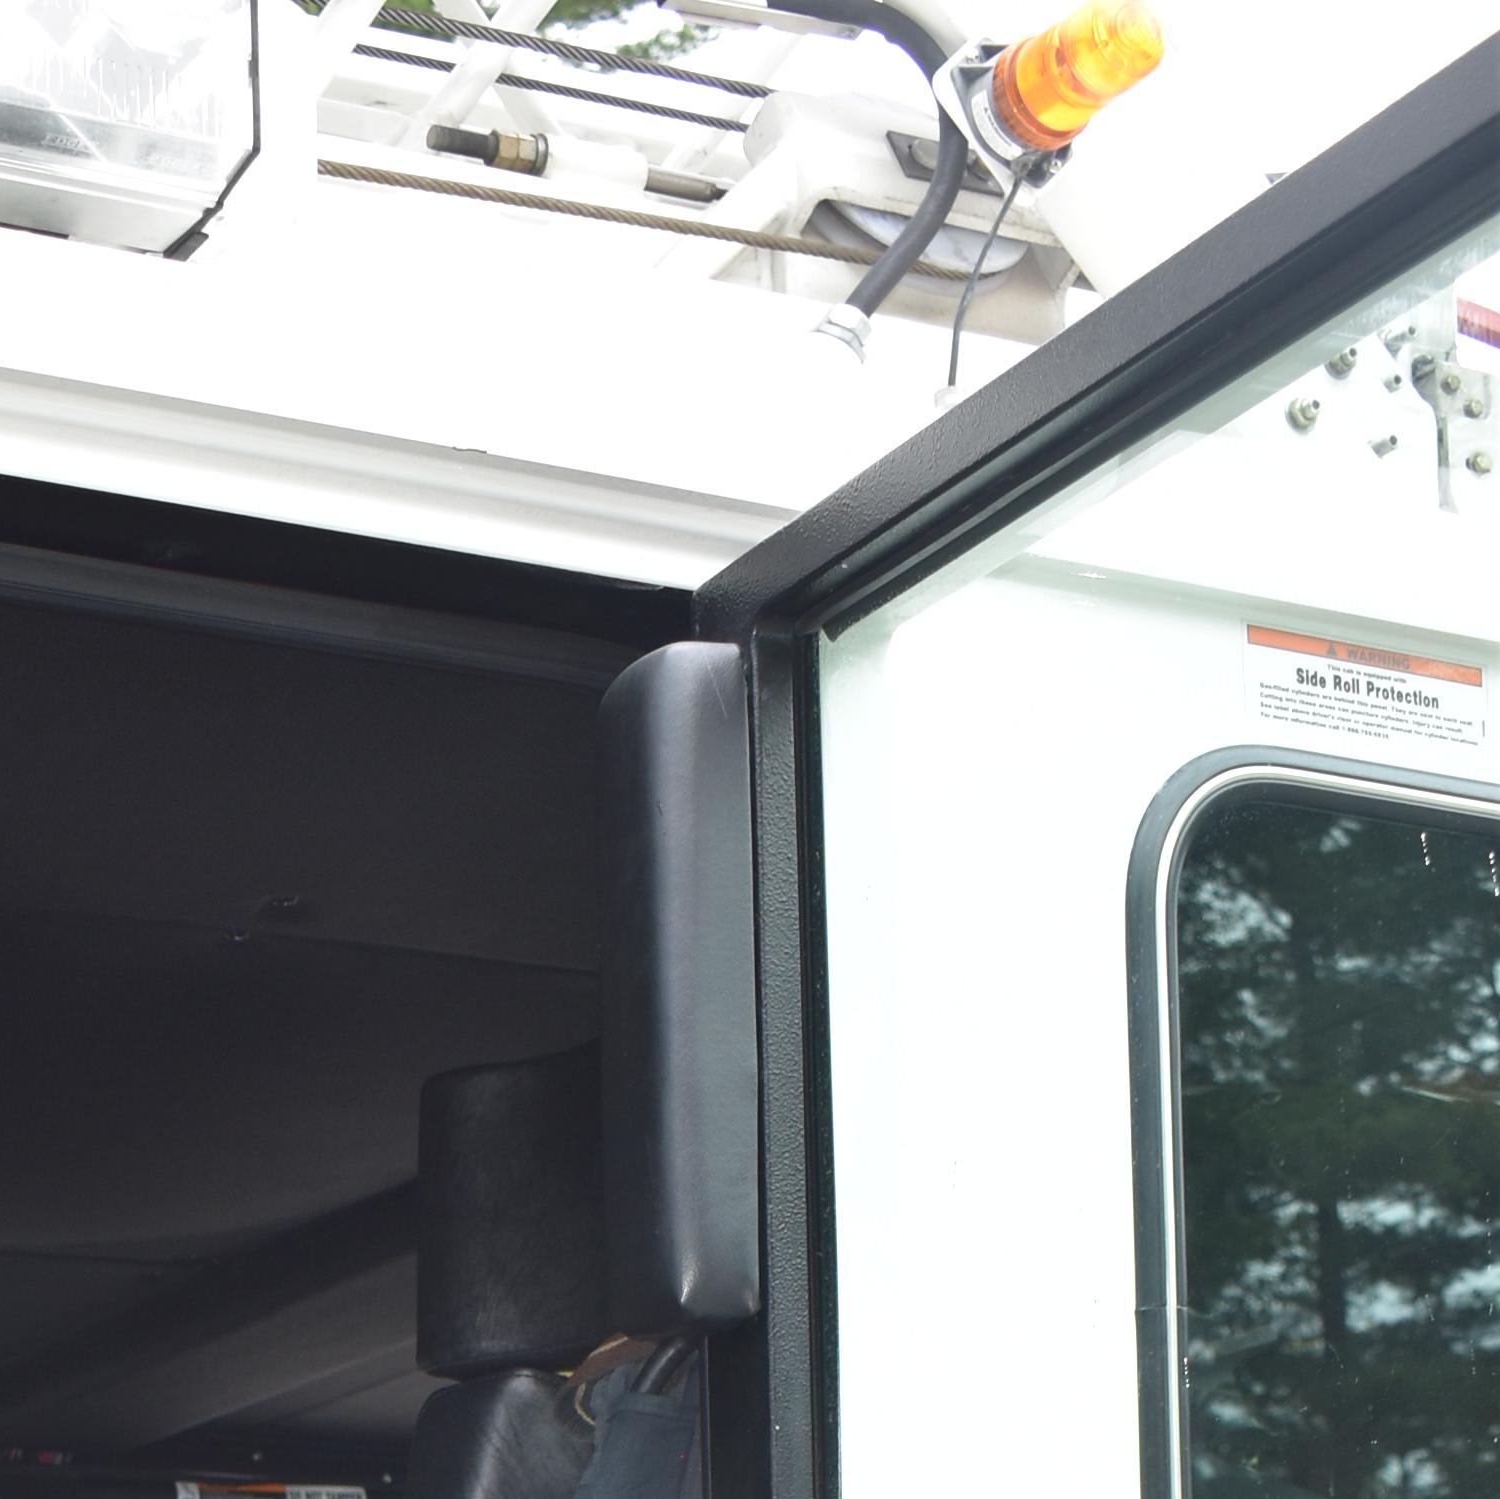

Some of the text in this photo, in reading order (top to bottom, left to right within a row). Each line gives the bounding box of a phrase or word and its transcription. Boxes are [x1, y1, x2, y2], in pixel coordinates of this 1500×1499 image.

[1347, 647, 1410, 670] WARNING
[1296, 667, 1439, 709] Side Roll Protection
